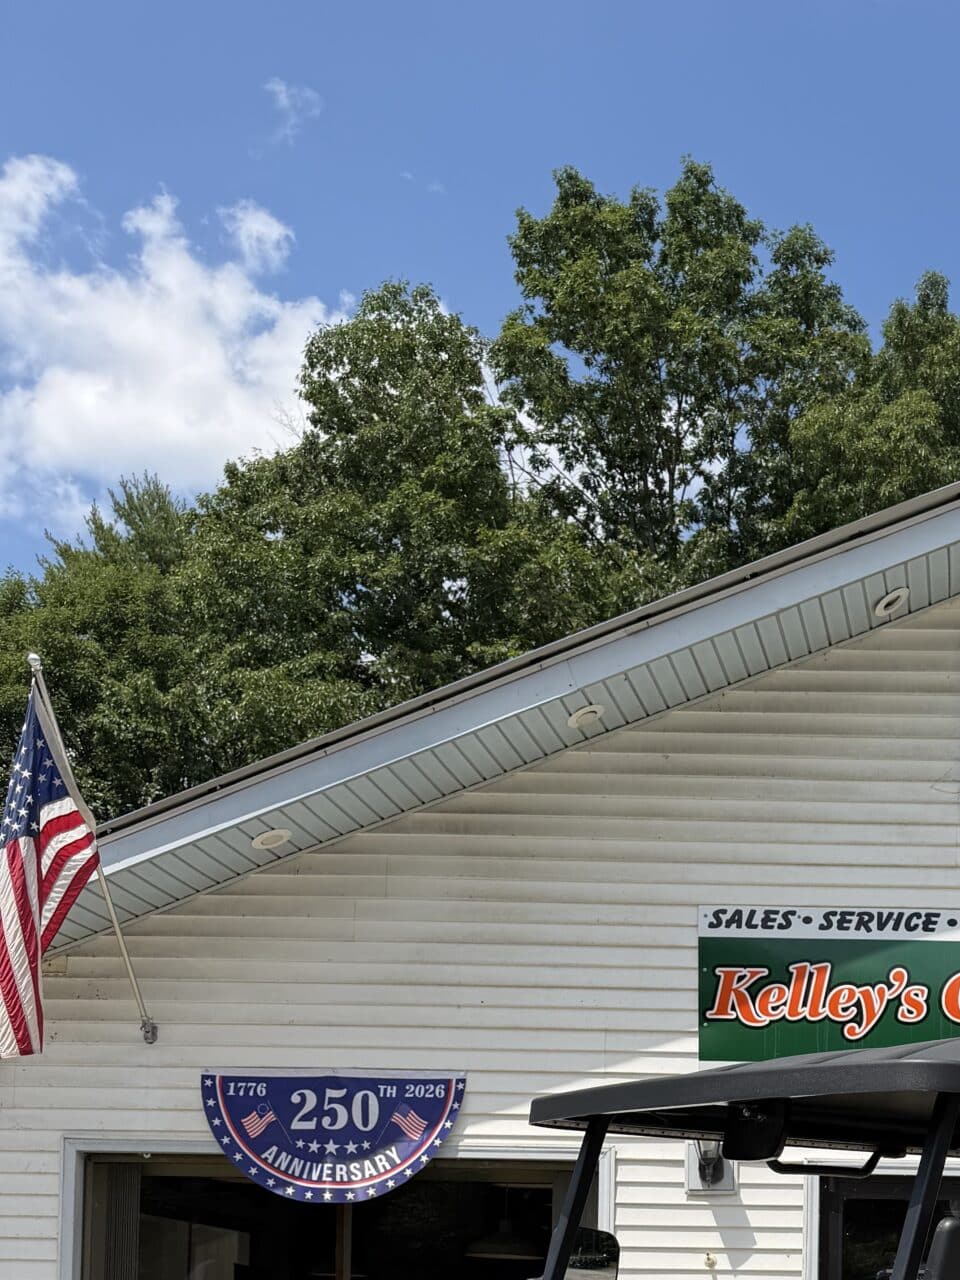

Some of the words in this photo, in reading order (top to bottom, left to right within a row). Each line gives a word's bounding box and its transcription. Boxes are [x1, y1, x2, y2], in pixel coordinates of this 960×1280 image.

[708, 909, 797, 930] SALES
[818, 911, 941, 933] SERVICE
[706, 962, 928, 1040] Kelley's
[227, 1082, 267, 1097] 1776
[404, 1083, 445, 1098] 2026
[261, 1145, 402, 1182] ANNIVERSARY
